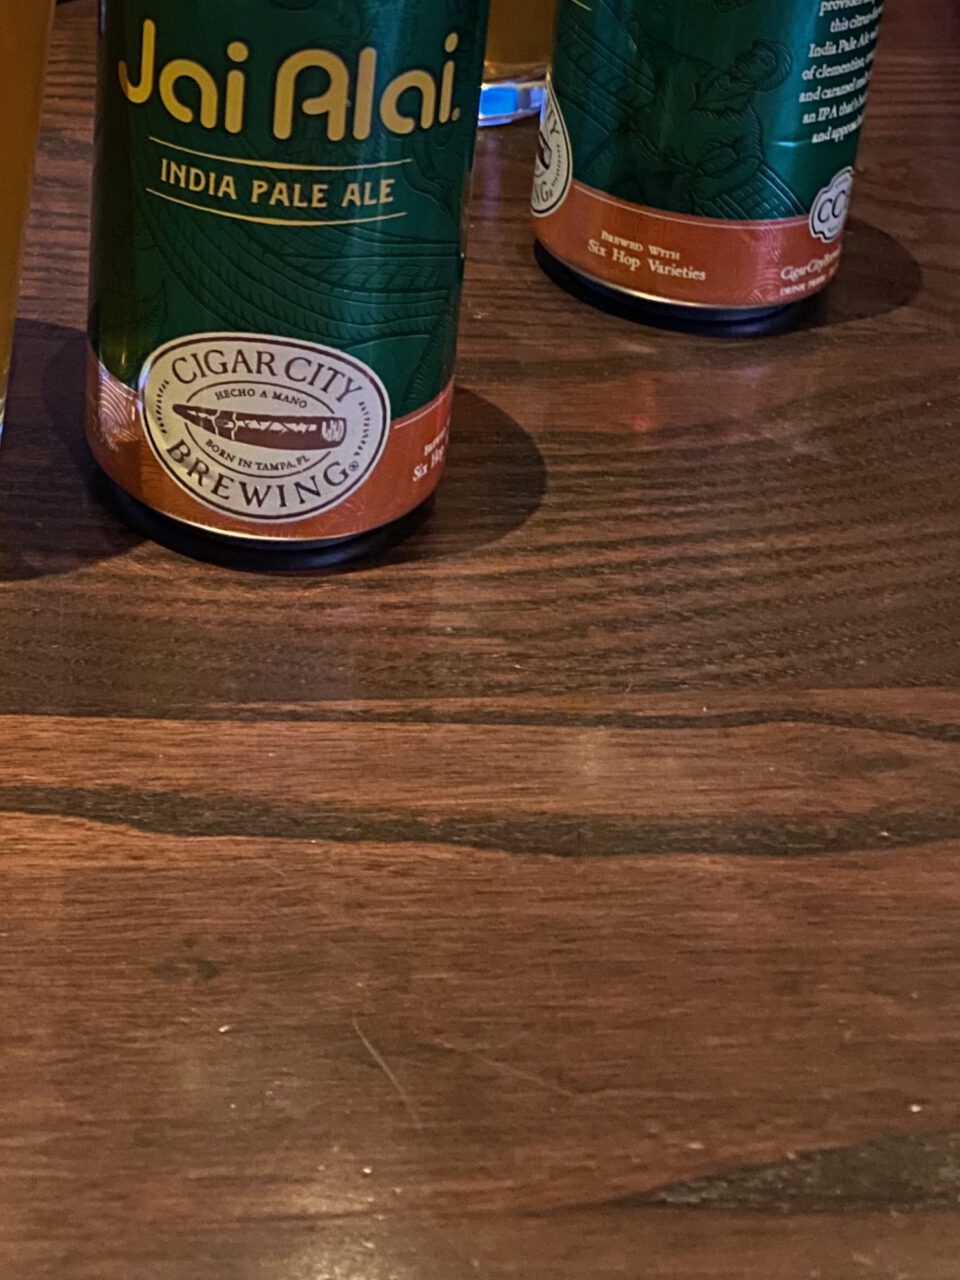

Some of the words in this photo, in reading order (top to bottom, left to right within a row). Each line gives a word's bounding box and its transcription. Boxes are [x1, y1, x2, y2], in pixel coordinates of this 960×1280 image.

[830, 18, 849, 32] this
[808, 43, 837, 58] India
[838, 36, 858, 54] Pale
[118, 18, 249, 135] Jai
[802, 65, 817, 81] of
[799, 86, 822, 103] and
[802, 113, 817, 125] an
[817, 104, 838, 122] IPA
[811, 126, 833, 144] and
[160, 158, 238, 201] INDIA
[250, 179, 329, 208] PALE
[341, 178, 396, 208] ALE
[587, 239, 607, 262] Six
[612, 248, 641, 272] Hop
[647, 257, 707, 282] Varieties
[171, 348, 278, 385] CIGAR
[284, 356, 363, 403] CITY
[214, 387, 256, 401] HECHO
[259, 389, 269, 399] A
[271, 390, 308, 409] MANO
[204, 438, 237, 463] BORN
[238, 457, 253, 469] IN
[297, 454, 311, 467] FL
